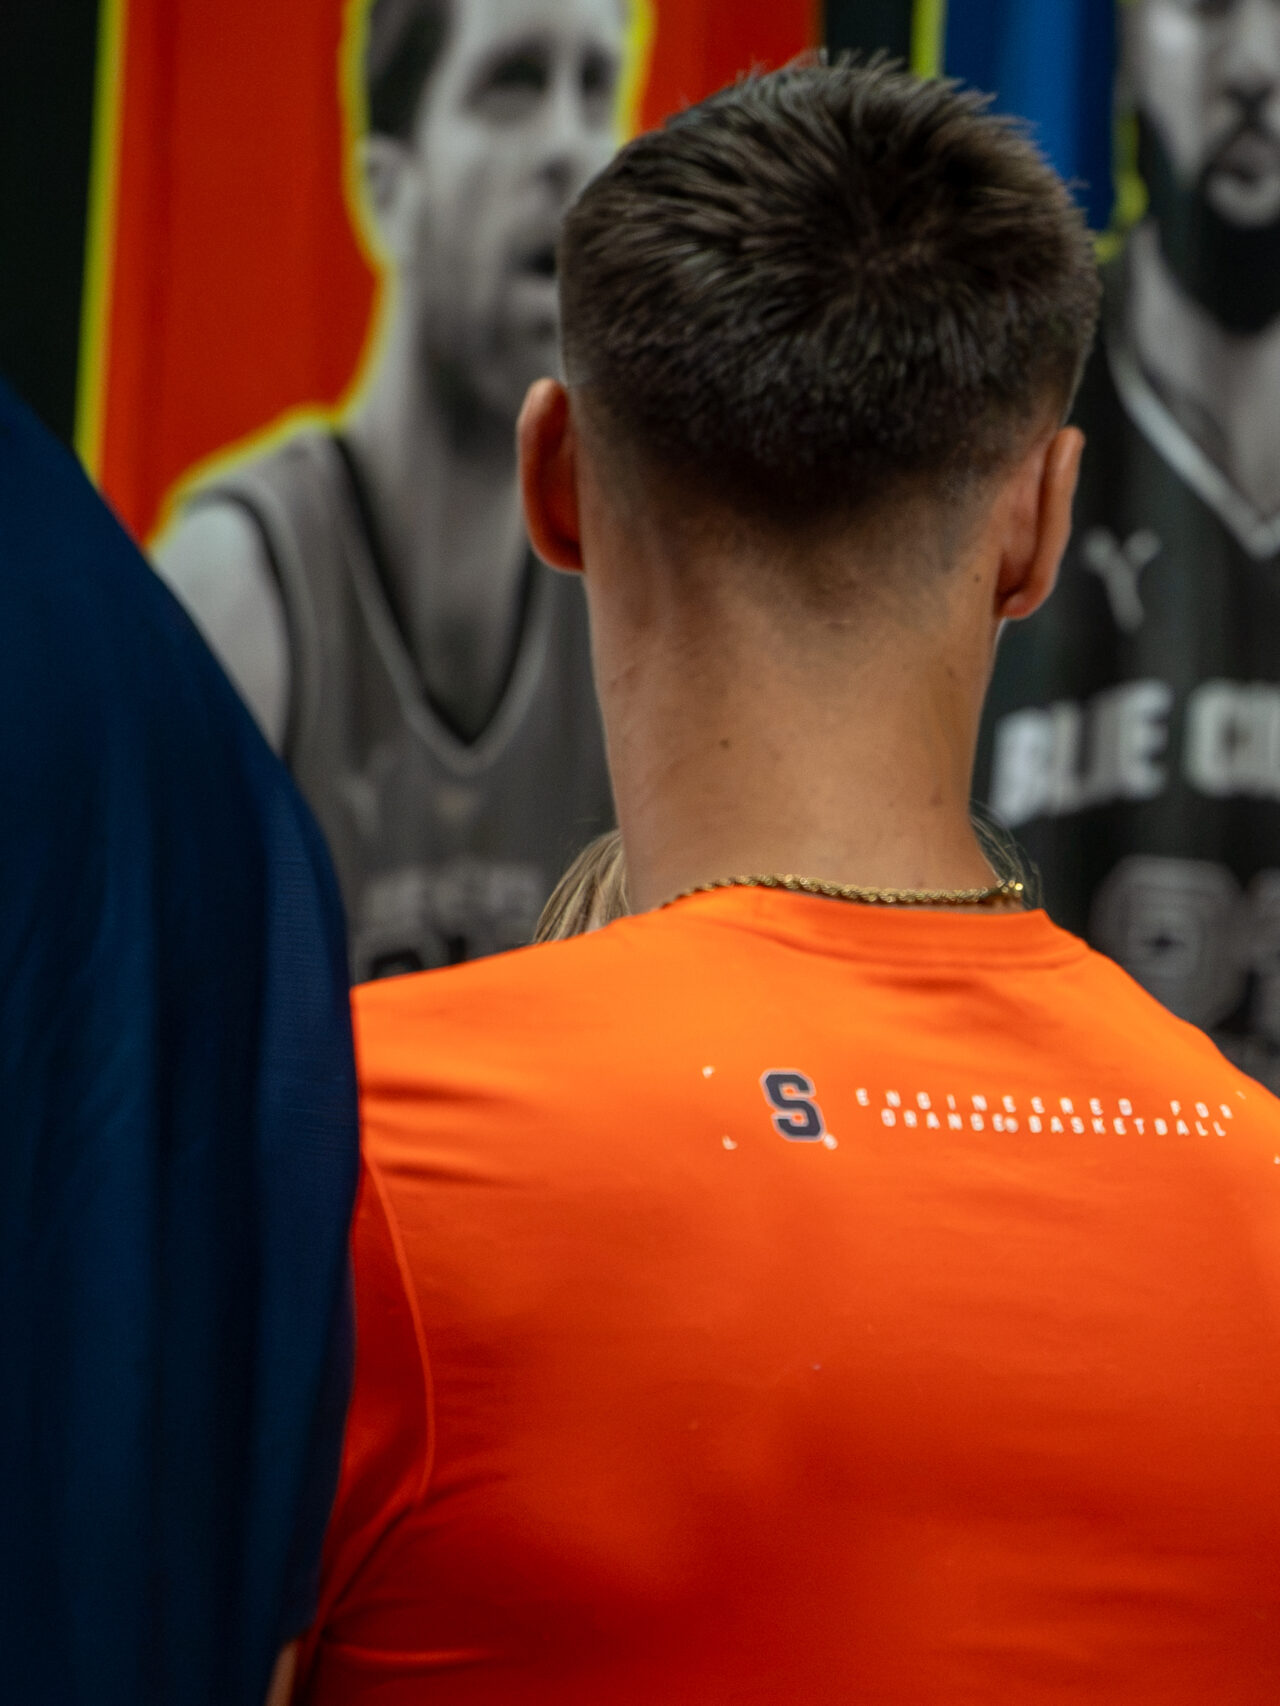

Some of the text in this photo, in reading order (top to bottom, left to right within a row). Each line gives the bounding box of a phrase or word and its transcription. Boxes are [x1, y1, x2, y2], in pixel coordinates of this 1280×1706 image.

[760, 1067, 826, 1143] S
[855, 1086, 1233, 1120] ENGINEERED FOR
[1027, 1114, 1227, 1137] BASKETBALL
